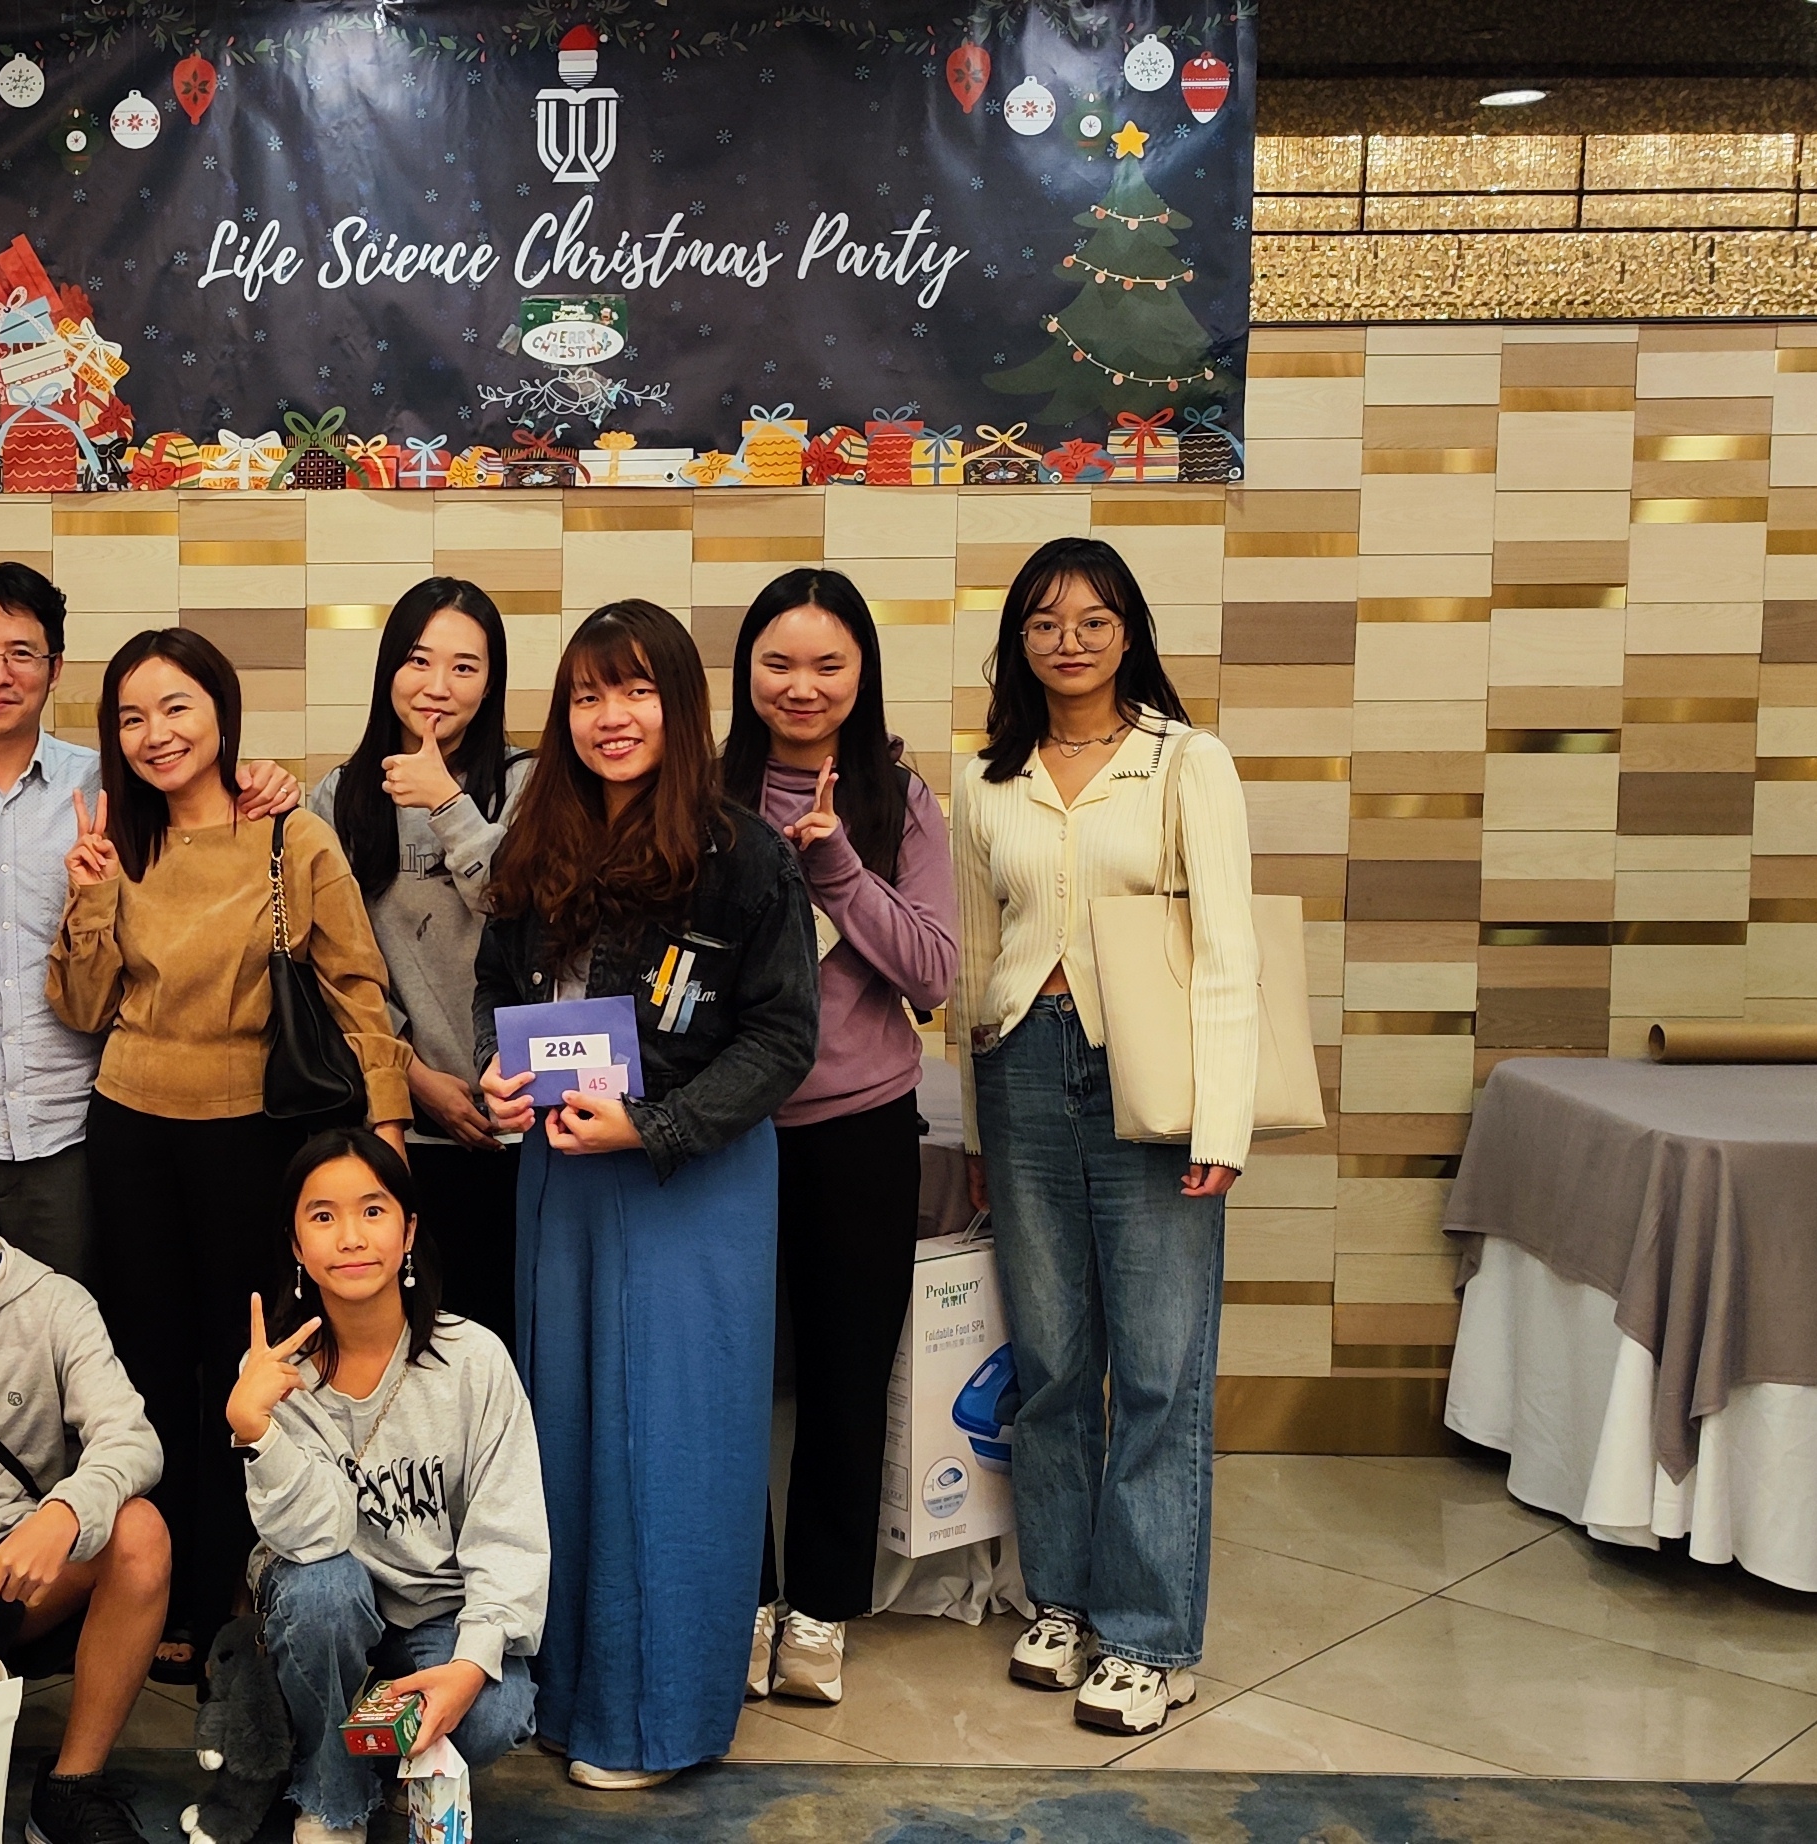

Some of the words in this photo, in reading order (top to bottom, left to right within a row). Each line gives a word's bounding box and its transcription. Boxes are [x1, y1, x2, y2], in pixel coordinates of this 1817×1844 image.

[197, 218, 305, 303] Life
[317, 215, 501, 290] Science
[513, 193, 784, 290] Christmas
[797, 208, 971, 310] Party
[547, 327, 596, 344] MERRY
[544, 1040, 588, 1058] 28A
[588, 1076, 609, 1092] 45
[925, 1278, 983, 1299] Proluxury
[925, 1327, 954, 1342] Foldable
[955, 1324, 970, 1336] Foot
[971, 1319, 984, 1332] SPA
